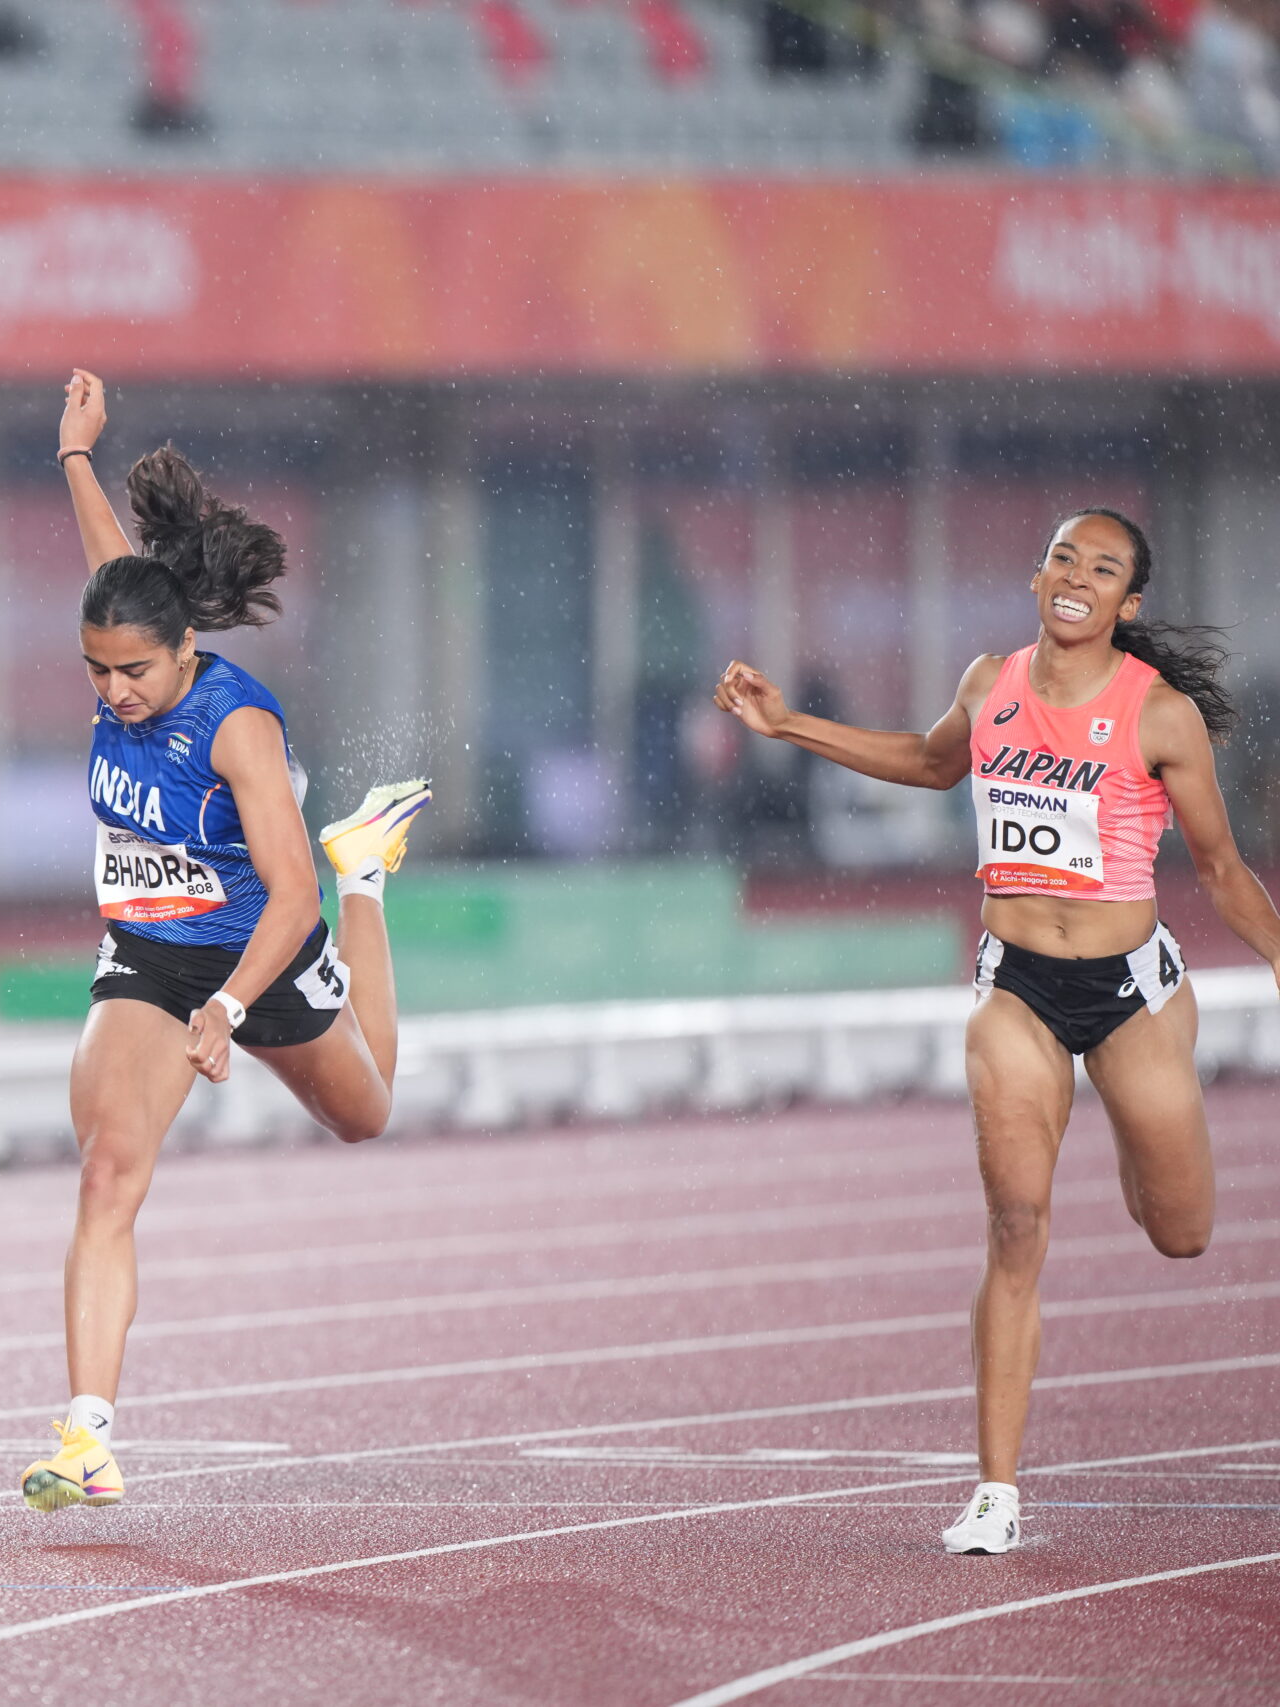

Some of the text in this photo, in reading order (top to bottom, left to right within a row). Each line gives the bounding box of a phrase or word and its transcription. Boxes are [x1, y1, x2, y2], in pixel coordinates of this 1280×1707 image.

[168, 737, 190, 756] INDIA
[981, 746, 1108, 793] JAPAN
[90, 755, 166, 832] INDIA
[988, 788, 1067, 813] BORNAN
[991, 818, 1061, 855] IDO
[102, 853, 208, 889] BHADRA
[1069, 857, 1093, 868] 418
[187, 882, 214, 896] 808
[1000, 875, 1068, 886] Aichi-Nagoya 2026
[176, 905, 195, 914] 2026
[317, 953, 345, 998] 5
[1158, 938, 1180, 988] 4
